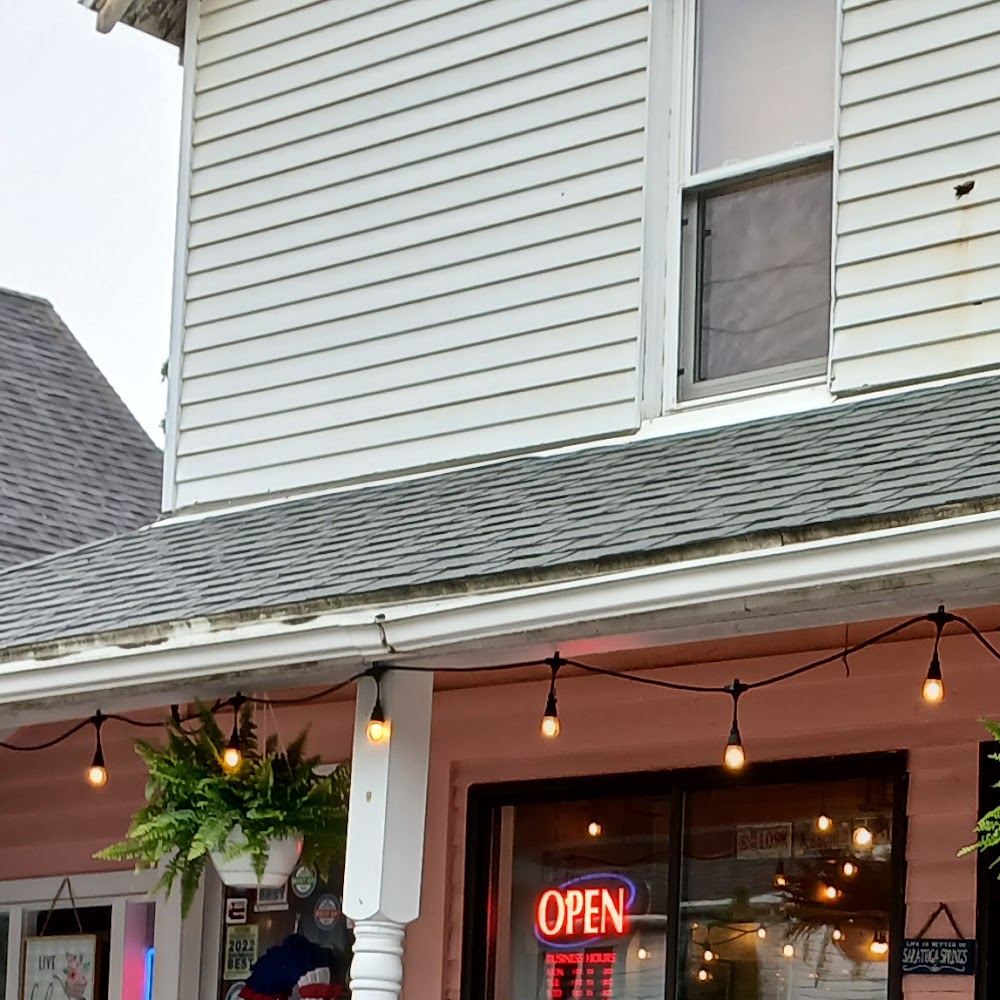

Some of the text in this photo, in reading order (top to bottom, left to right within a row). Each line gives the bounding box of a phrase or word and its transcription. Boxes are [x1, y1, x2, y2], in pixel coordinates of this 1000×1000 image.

[537, 887, 625, 936] OPEN
[229, 939, 256, 952] 2022
[38, 955, 56, 971] LIVE
[902, 947, 968, 965] SARATOGA SPRINGS
